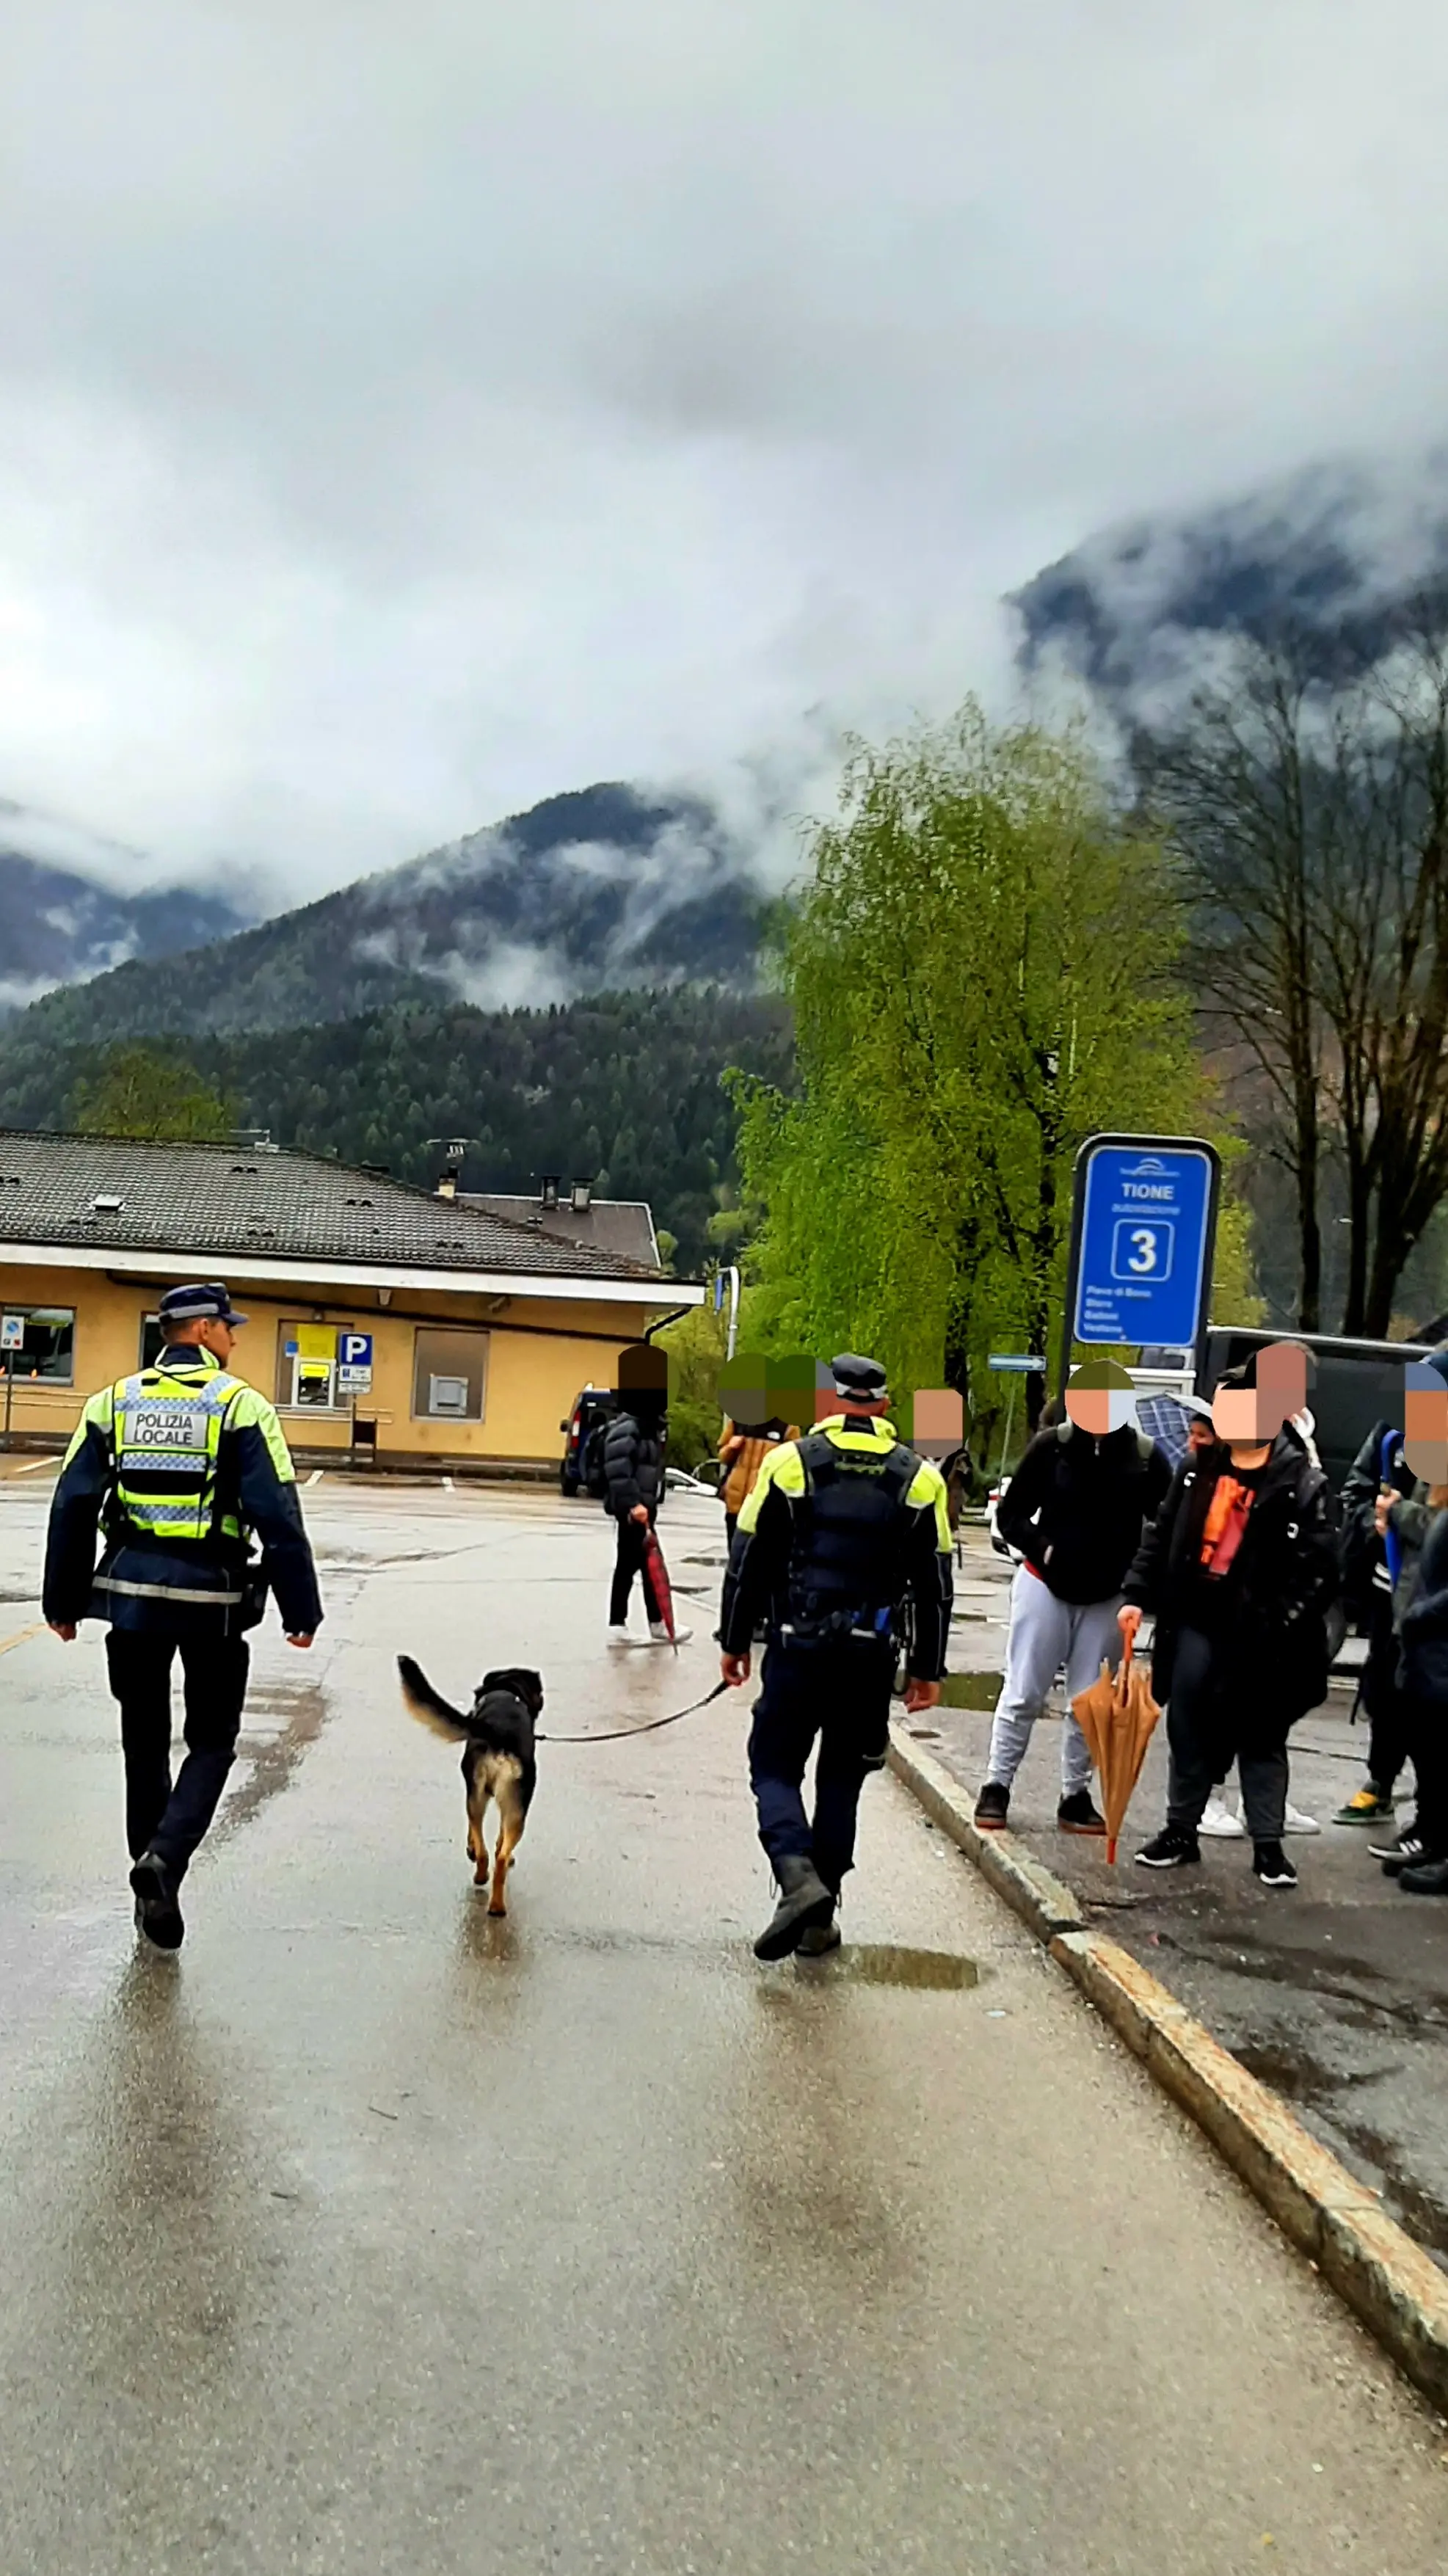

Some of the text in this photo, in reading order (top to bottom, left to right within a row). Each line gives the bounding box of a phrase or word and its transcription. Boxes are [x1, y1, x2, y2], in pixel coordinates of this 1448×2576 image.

[1121, 1182, 1174, 1200] TIONE
[1128, 1229, 1157, 1273] 3
[346, 1336, 368, 1363] P
[137, 1413, 193, 1429] POLIZIA
[134, 1428, 193, 1445] LOCALE
